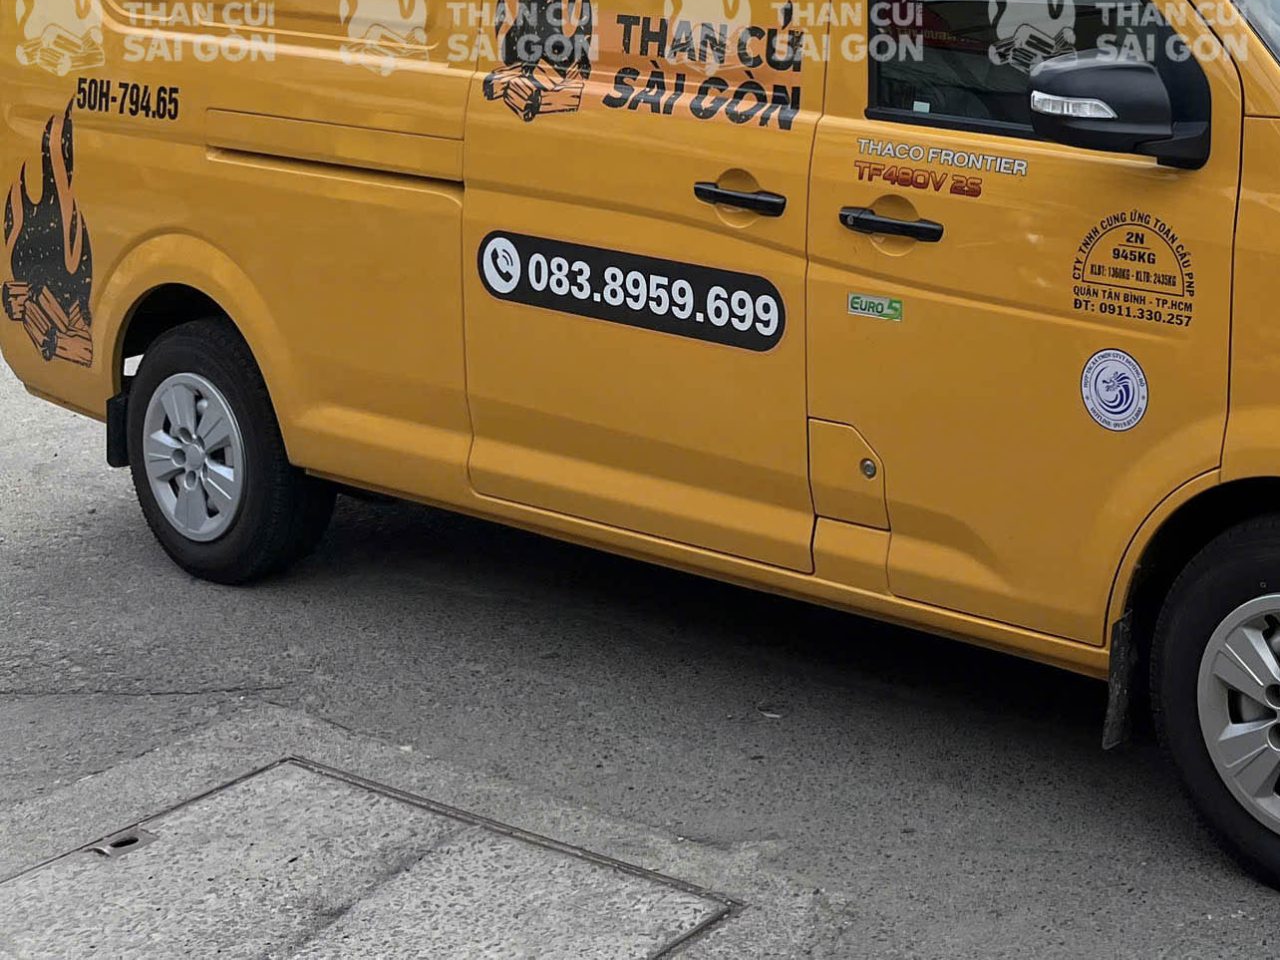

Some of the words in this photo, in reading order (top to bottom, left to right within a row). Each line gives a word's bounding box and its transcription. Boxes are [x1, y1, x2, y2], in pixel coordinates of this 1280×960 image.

[616, 14, 729, 65] THAN
[76, 77, 180, 121] 50H-794.65
[602, 60, 686, 116] SÀI
[689, 69, 802, 131] GÒN
[857, 138, 925, 161] THACO
[927, 148, 1028, 176] FRONTIER
[949, 175, 983, 198] 2S
[1072, 257, 1084, 280] CTY
[1079, 226, 1101, 254] TNHH
[1100, 212, 1127, 230] CUNG
[1153, 217, 1179, 245] TOÀN
[1184, 271, 1195, 297] PNP
[1112, 247, 1156, 265] 945KG
[1125, 231, 1145, 245] 2N
[527, 252, 780, 337] 083.8959.699
[1073, 285, 1099, 301] QUẬN
[1101, 286, 1120, 302] TÂN
[1122, 289, 1146, 305] BÌNH
[1155, 296, 1193, 313] TP.HCM
[1073, 297, 1096, 313] ĐT:
[1099, 300, 1193, 327] 0911.330.257
